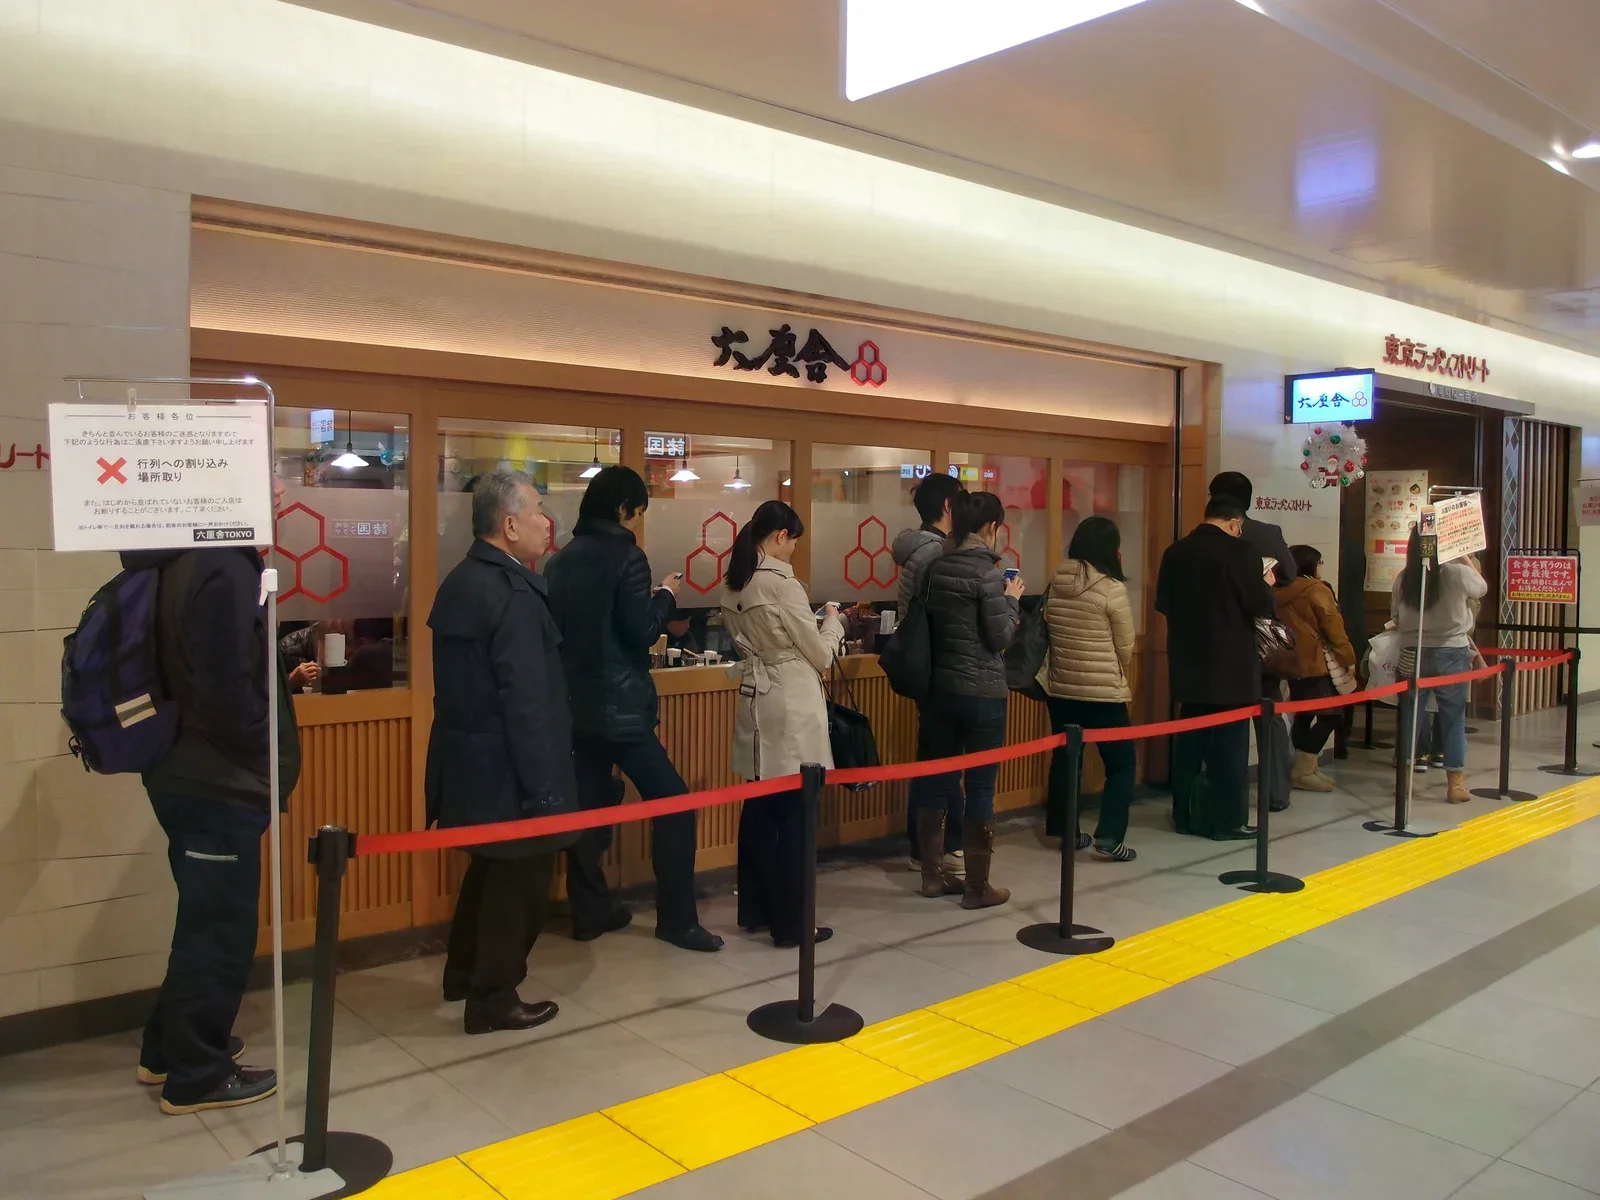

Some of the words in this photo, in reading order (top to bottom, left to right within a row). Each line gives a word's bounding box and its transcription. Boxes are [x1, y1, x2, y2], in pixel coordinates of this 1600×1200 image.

[1383, 334, 1491, 383] 東京ラーメンストリート
[81, 429, 238, 438] きちんと並んでいるお客様のご迷惑となりますので
[137, 458, 229, 469] 行列への割り込み
[137, 471, 182, 482] 場所取り
[1255, 496, 1313, 512] 東京ラーメンストリート
[1512, 560, 1572, 570] 食券を買うのは
